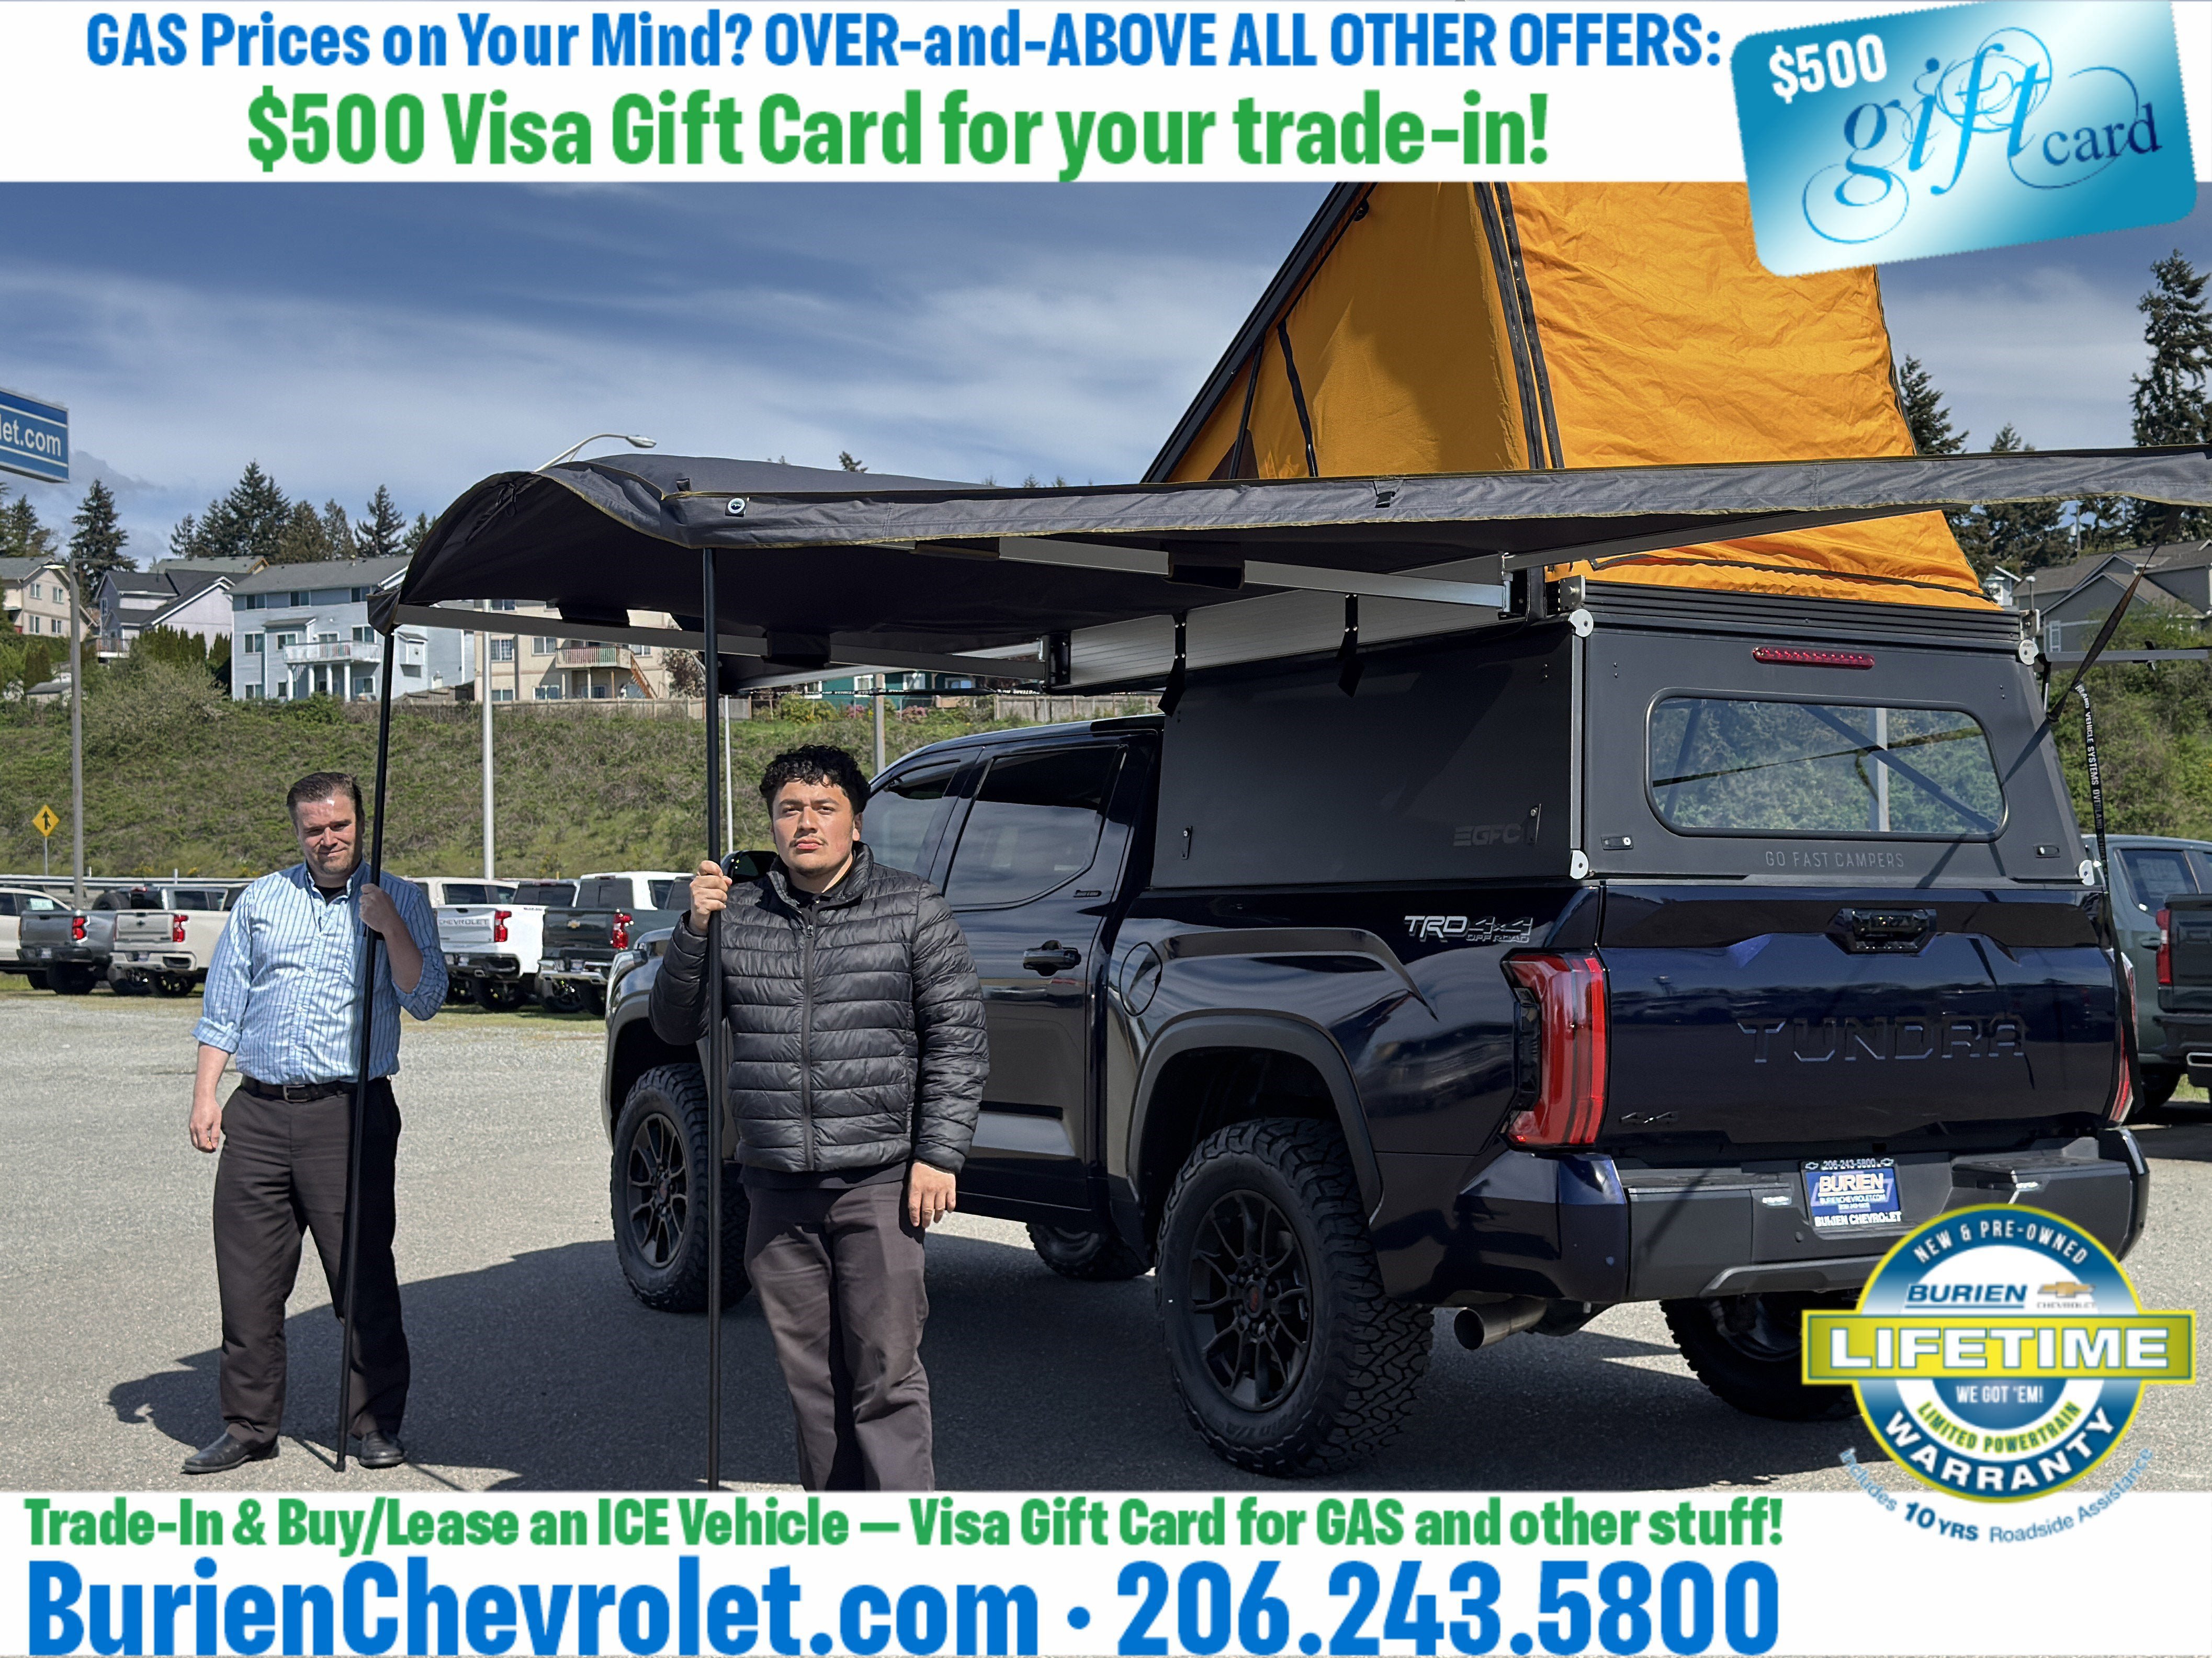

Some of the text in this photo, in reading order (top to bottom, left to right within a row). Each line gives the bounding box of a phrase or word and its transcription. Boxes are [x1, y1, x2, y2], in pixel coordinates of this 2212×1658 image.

[2087, 746, 2099, 785] SYSTEMS
[1765, 851, 1904, 868] GO FAST CAMPERS
[1404, 915, 1469, 940] TRD
[1736, 1013, 2027, 1063] TUNDRA
[1819, 1173, 1884, 1193] BURIEN
